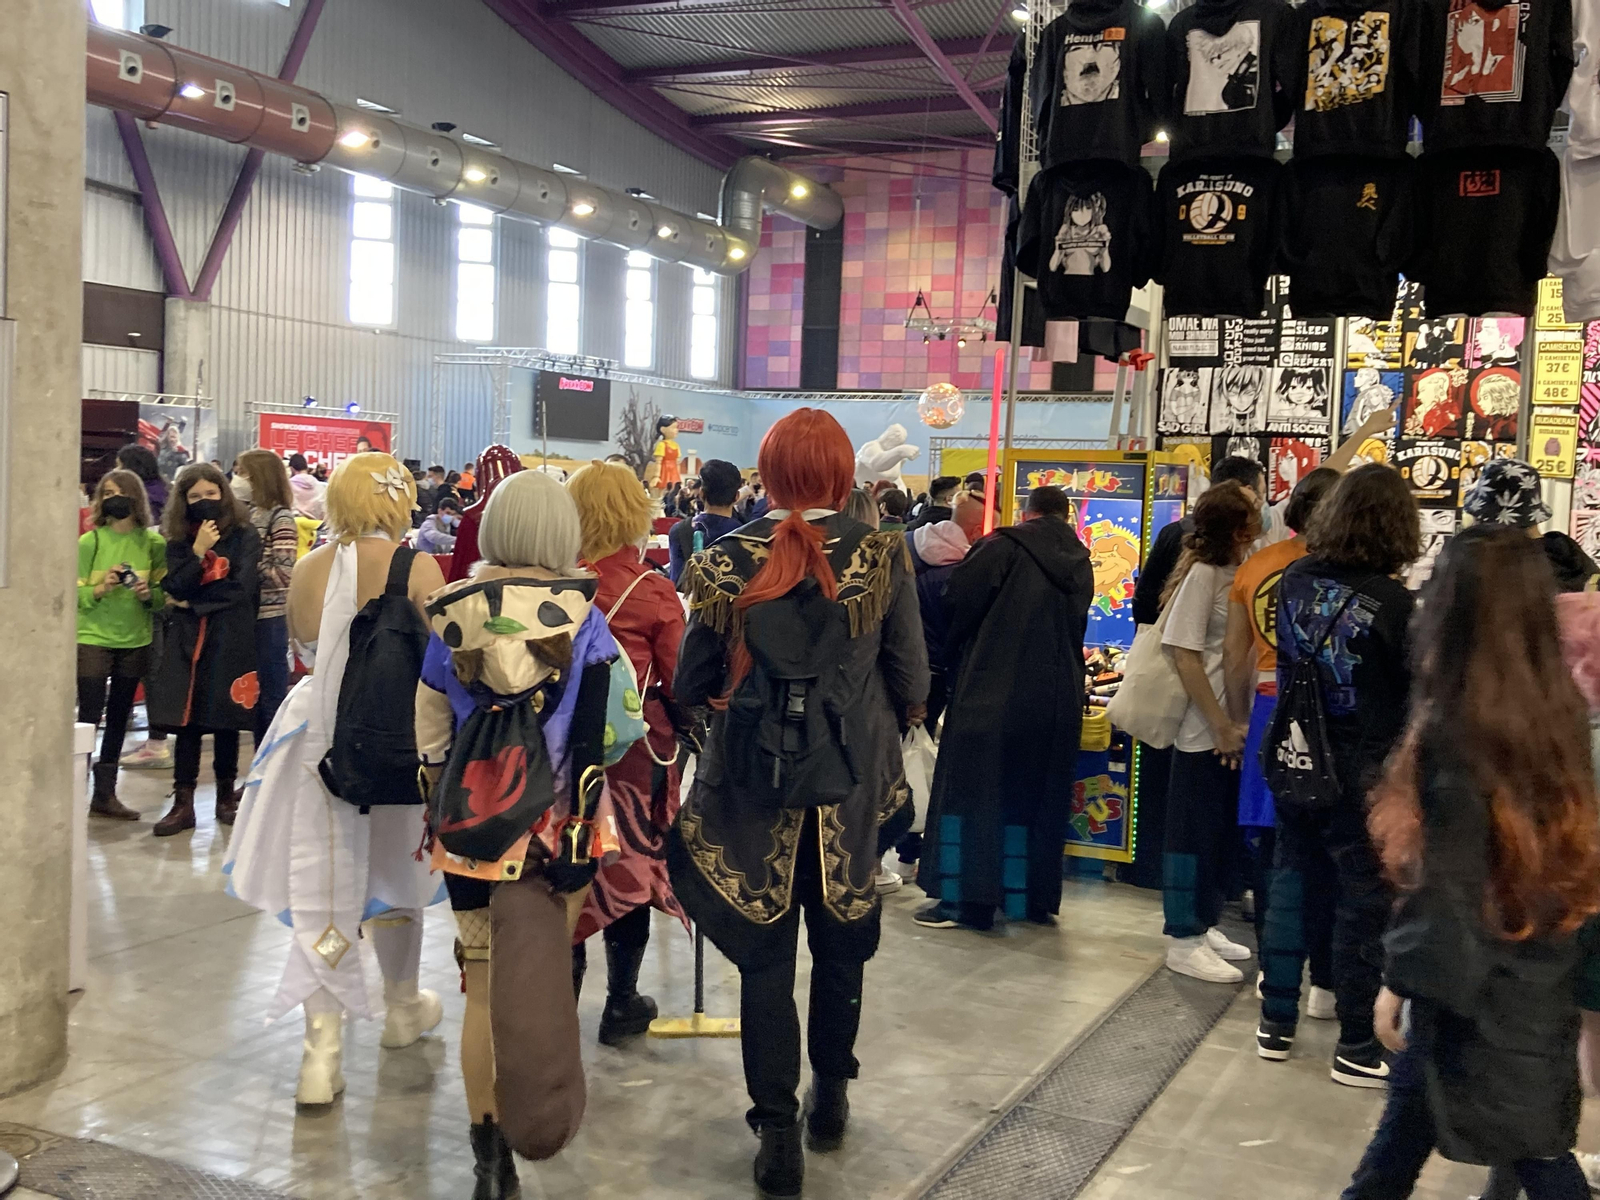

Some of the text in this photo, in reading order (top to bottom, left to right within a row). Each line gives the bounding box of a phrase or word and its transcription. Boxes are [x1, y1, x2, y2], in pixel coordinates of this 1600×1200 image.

[1064, 30, 1104, 44] Hentai
[1176, 180, 1254, 198] KARASUNO
[1547, 313, 1562, 323] 25
[1202, 318, 1219, 331] WA
[1296, 326, 1329, 335] SLEEP
[1294, 342, 1327, 351] ANIME
[1540, 343, 1580, 352] CAMISETAS
[1293, 358, 1334, 367] REPEAT
[1157, 421, 1208, 434] SAD GIRL
[1266, 423, 1329, 434] ANTI SOCIAL
[270, 430, 299, 449] LE
[303, 431, 358, 452] CHEF
[1076, 470, 1123, 494] PLUS
